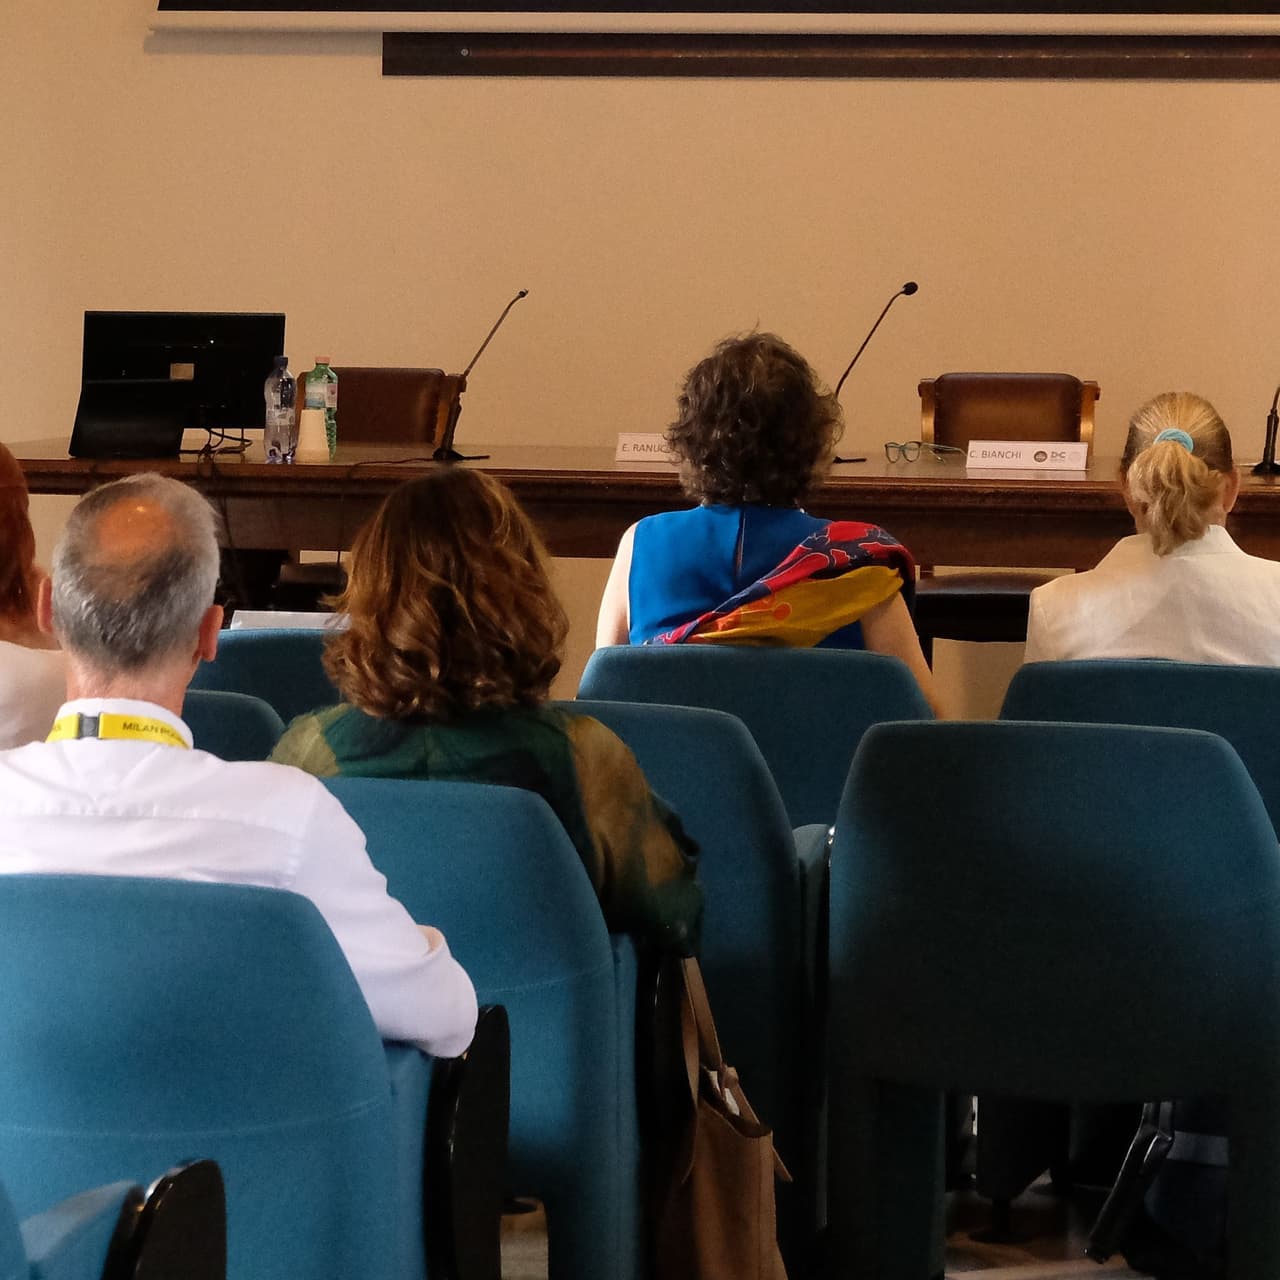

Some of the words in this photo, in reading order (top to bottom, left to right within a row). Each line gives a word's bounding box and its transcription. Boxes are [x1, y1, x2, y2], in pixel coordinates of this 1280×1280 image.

[632, 443, 672, 454] RANUC
[969, 450, 978, 459] C.
[981, 450, 1022, 460] BIANCHI
